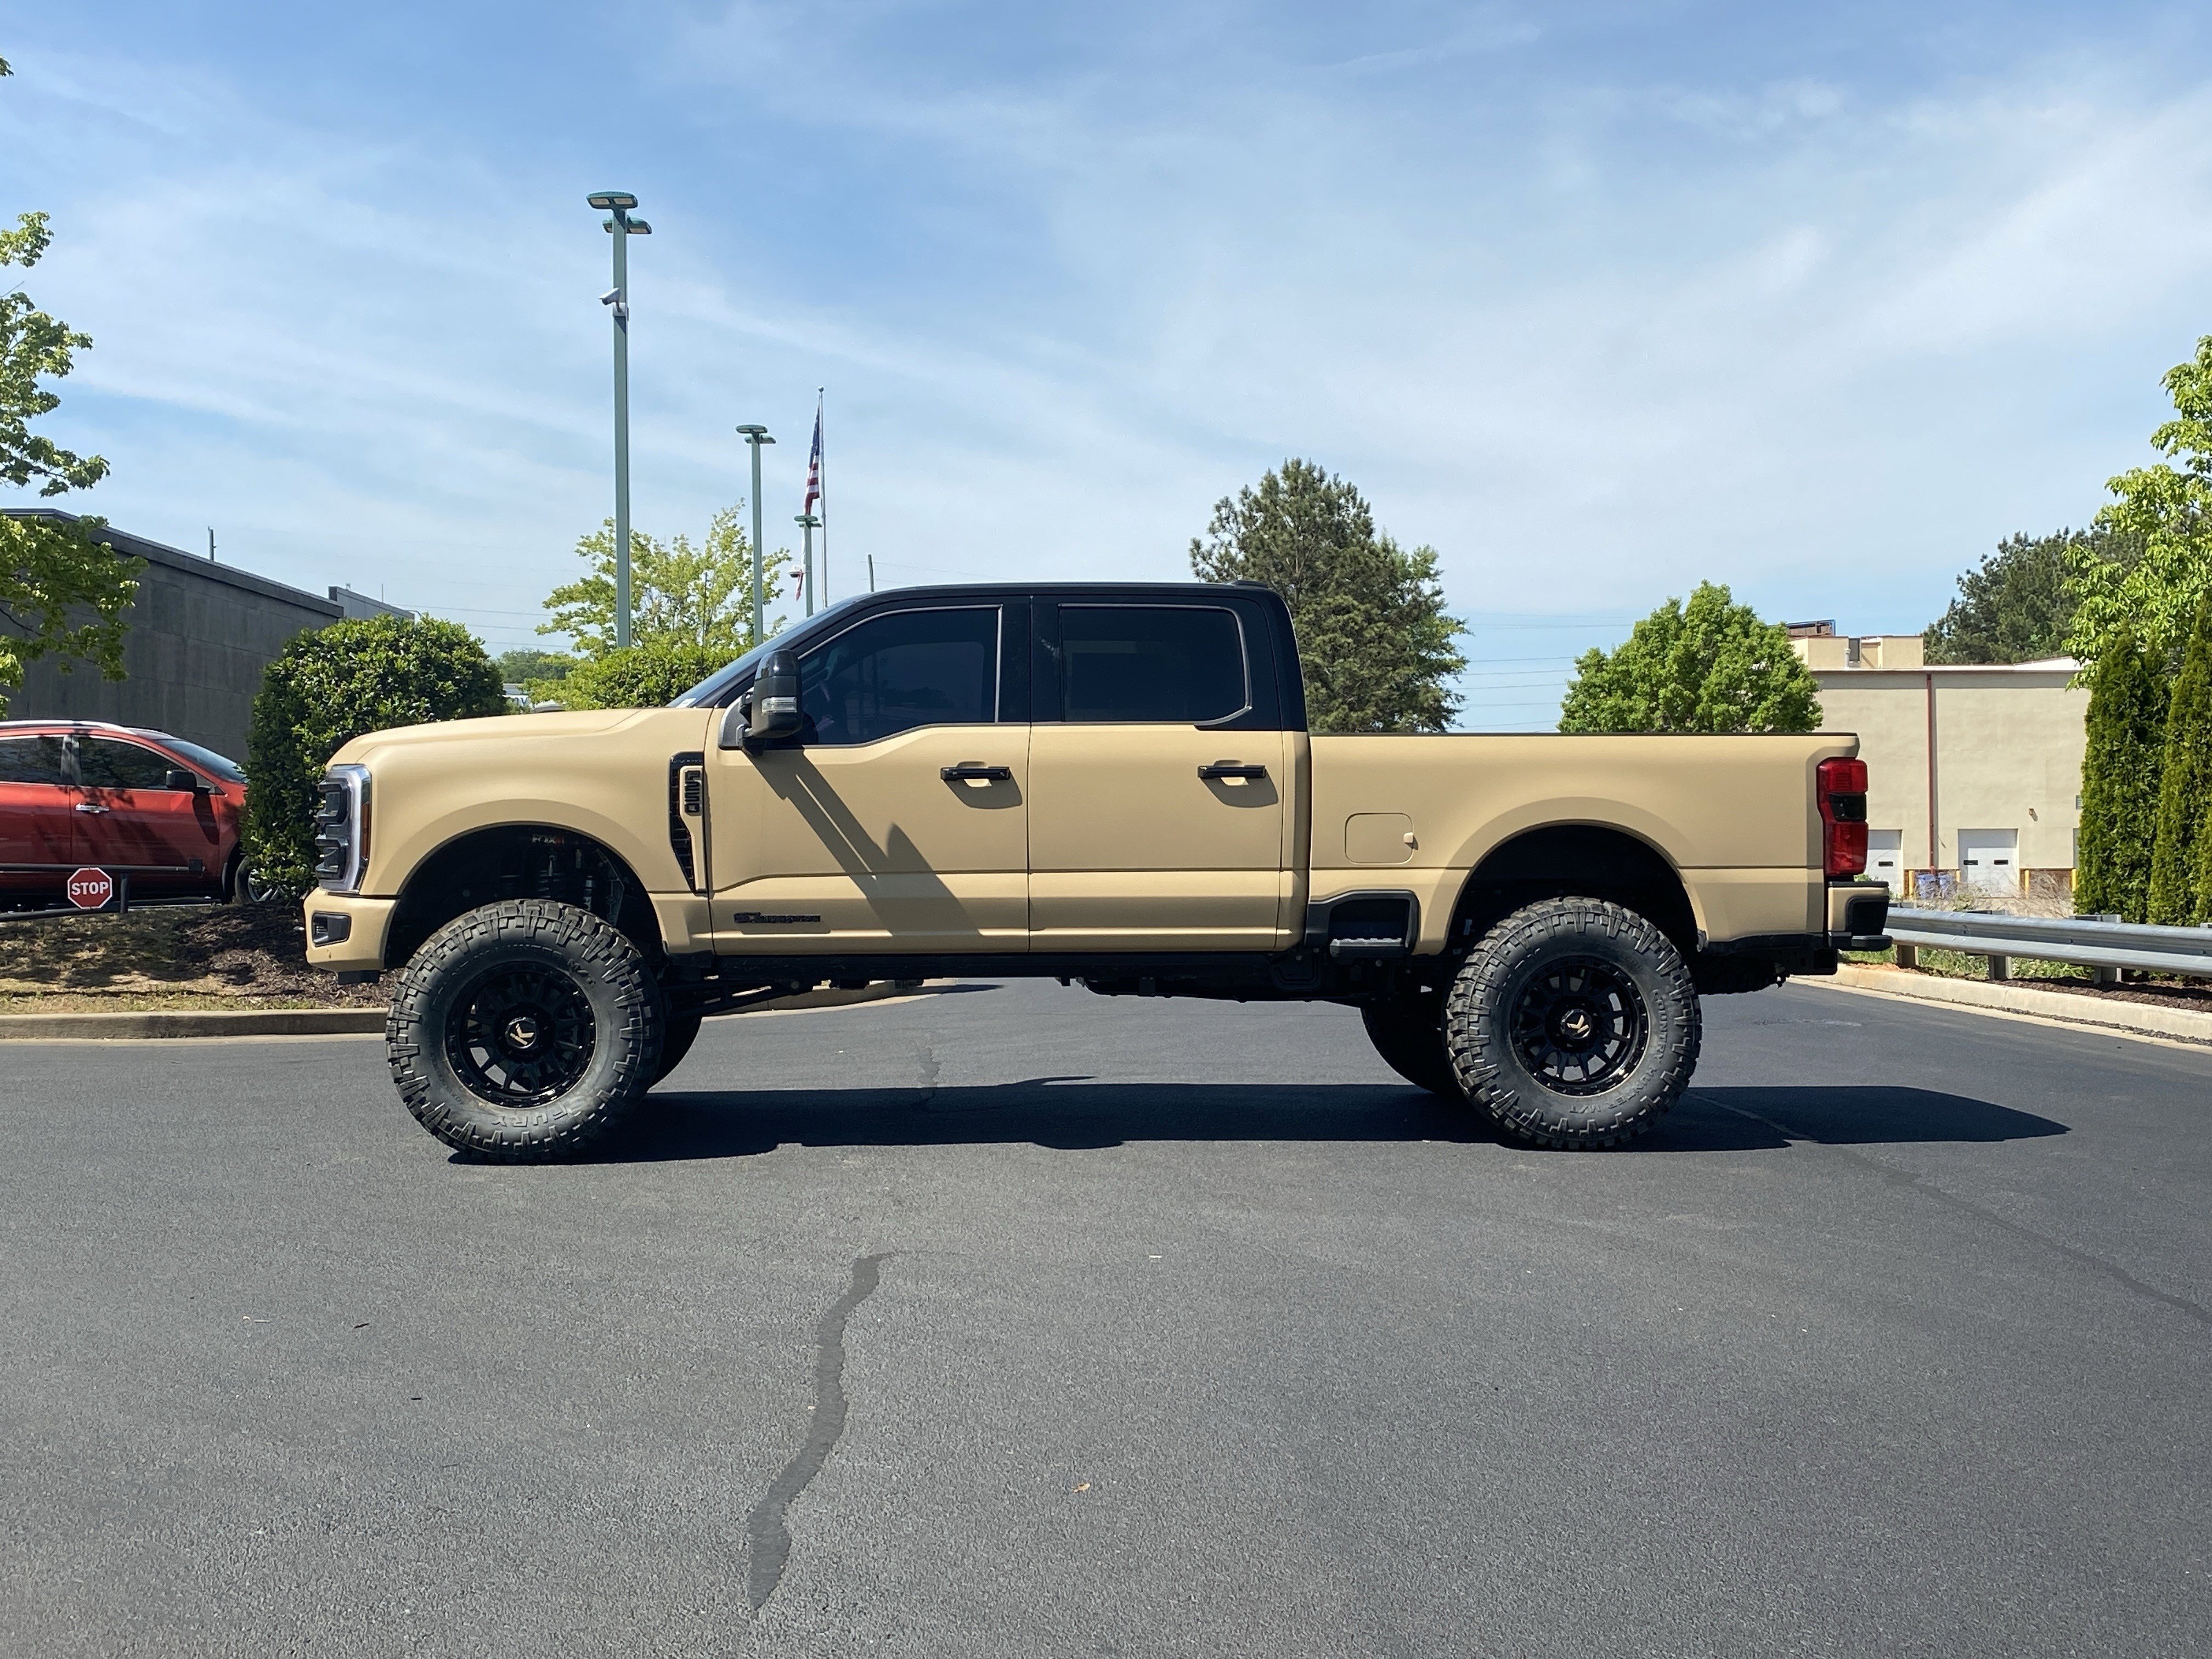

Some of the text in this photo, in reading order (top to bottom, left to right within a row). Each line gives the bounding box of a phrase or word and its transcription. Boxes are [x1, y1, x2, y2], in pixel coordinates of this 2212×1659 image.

[71, 881, 109, 895] STOP
[1652, 989, 1668, 1063] COUNTRY
[1606, 1065, 1657, 1109] HUNTER
[491, 1102, 568, 1127] FURY
